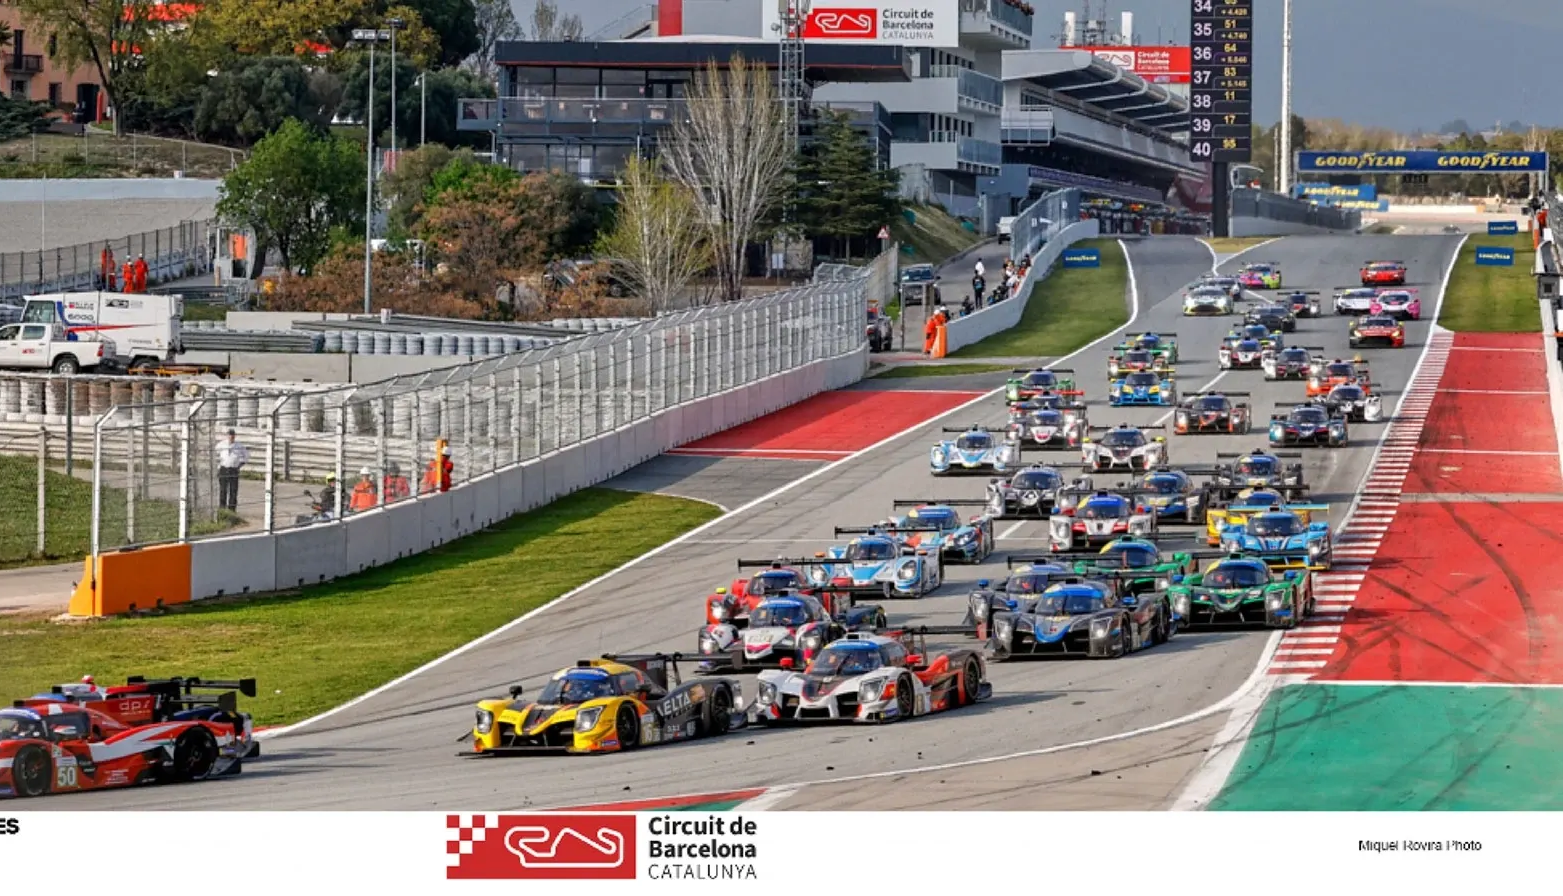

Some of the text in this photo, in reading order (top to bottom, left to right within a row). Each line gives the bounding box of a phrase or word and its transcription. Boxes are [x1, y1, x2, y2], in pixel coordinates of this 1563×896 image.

[1194, 0, 1213, 12] 34
[882, 8, 934, 19] Circuit de
[882, 20, 934, 29] Barcelona
[1194, 19, 1236, 36] 35 51
[882, 31, 934, 39] CATALUNYA
[1194, 46, 1213, 60] 36
[1194, 70, 1212, 84] 37
[1193, 91, 1236, 108] 38 11
[1193, 115, 1236, 132] 39 17
[1192, 142, 1211, 156] 40
[1315, 152, 1407, 169] GOODYEAR
[1438, 152, 1530, 169] GOODYEAR
[58, 766, 77, 786] 50
